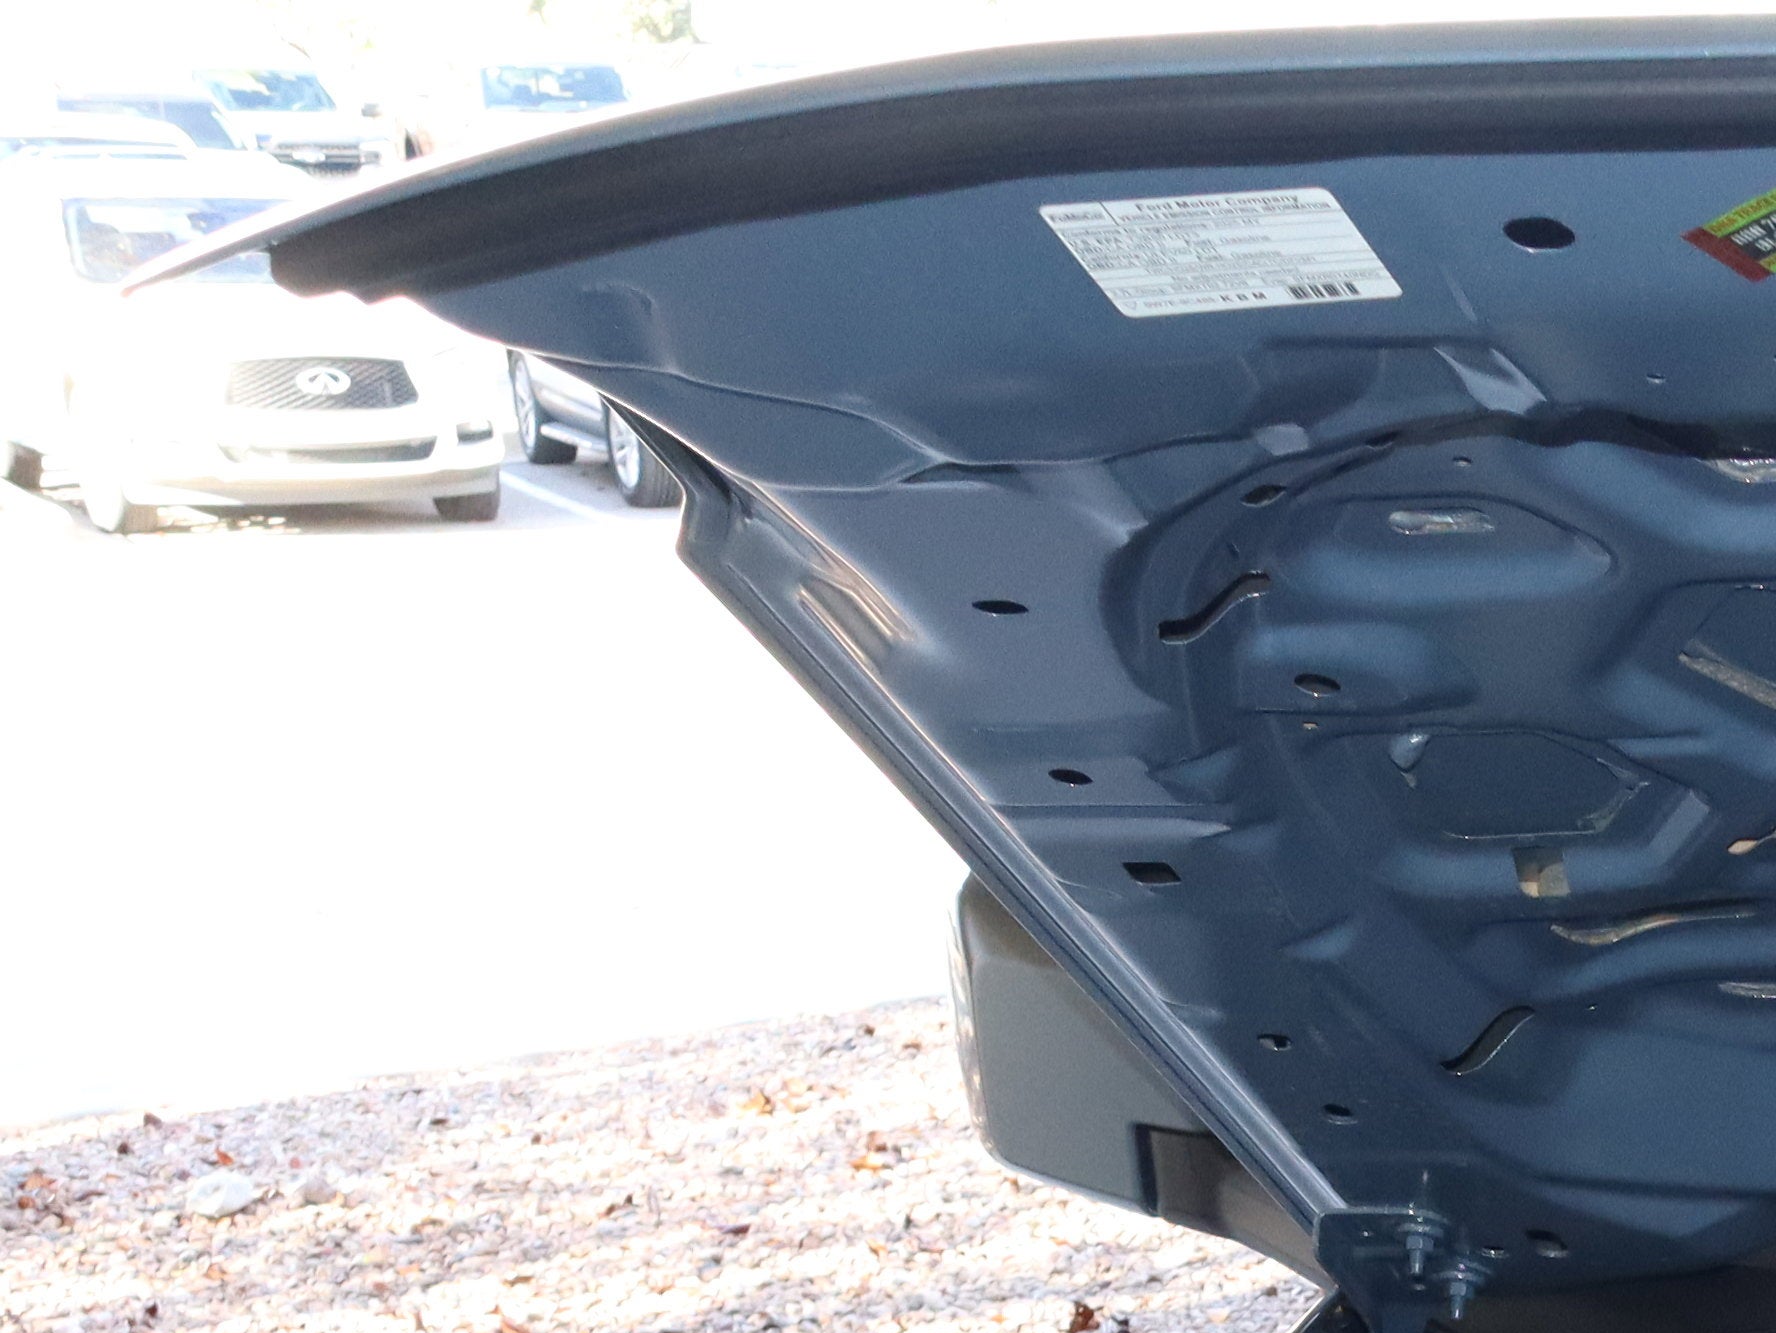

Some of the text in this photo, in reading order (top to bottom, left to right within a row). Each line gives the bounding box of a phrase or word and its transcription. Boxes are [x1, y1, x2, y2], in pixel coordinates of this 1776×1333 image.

[1134, 193, 1302, 211] Ford Motor Company
